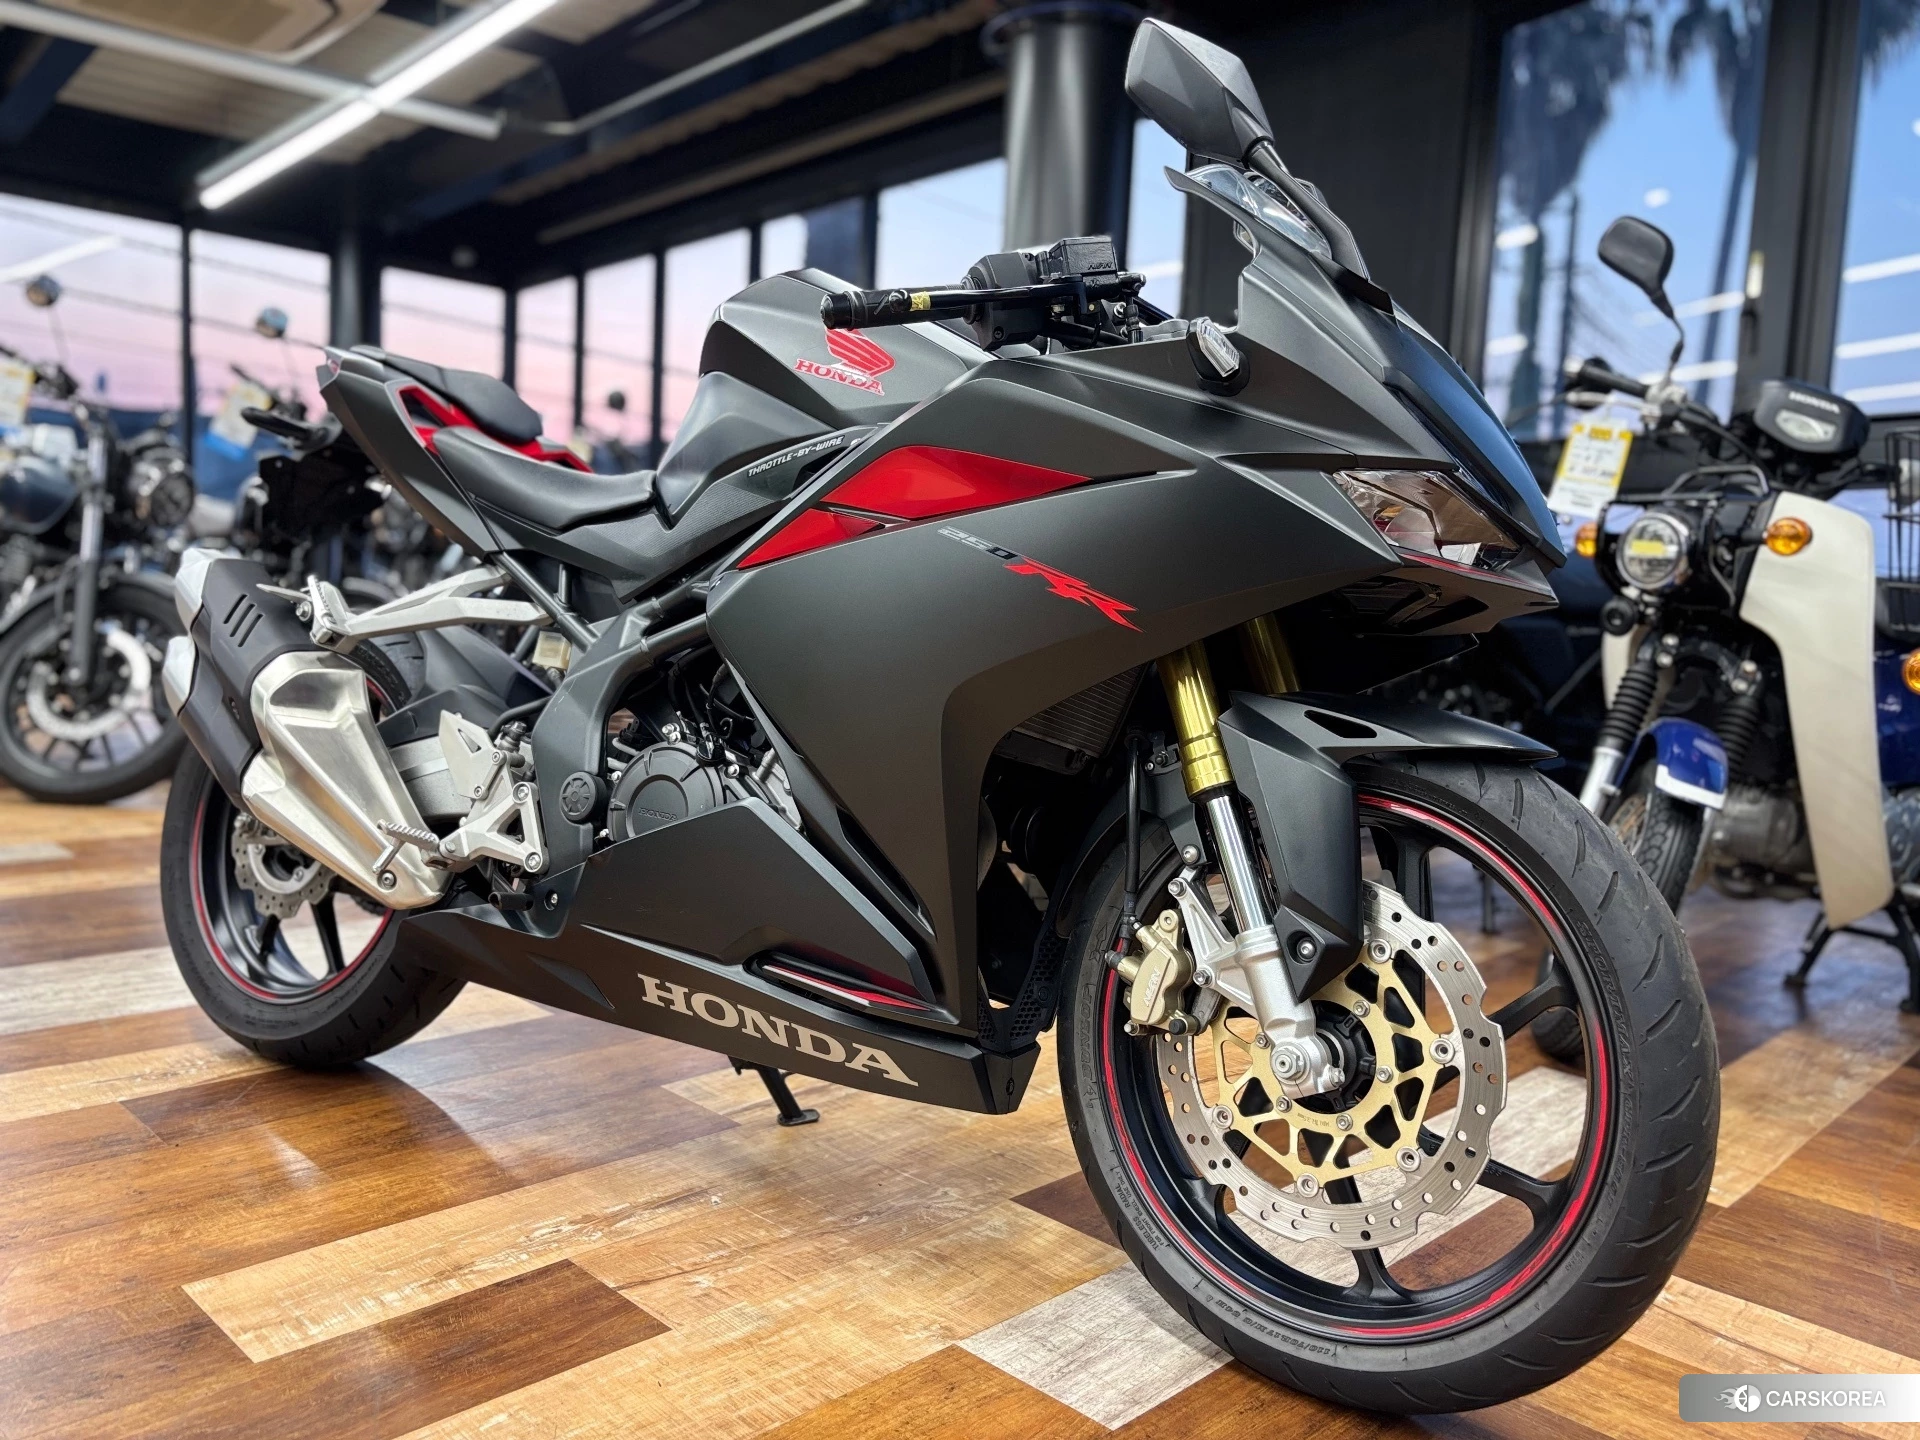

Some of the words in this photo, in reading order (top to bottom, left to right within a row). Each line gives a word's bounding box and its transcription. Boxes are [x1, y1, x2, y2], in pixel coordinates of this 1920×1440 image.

[795, 359, 884, 395] HONDA
[748, 436, 843, 477] THROTTLE-BY-WIRE
[637, 973, 919, 1087] HONDA
[1080, 984, 1093, 1081] DUNLOP
[1115, 1183, 1131, 1209] RADIAL
[1133, 1216, 1160, 1251] TUBELESS
